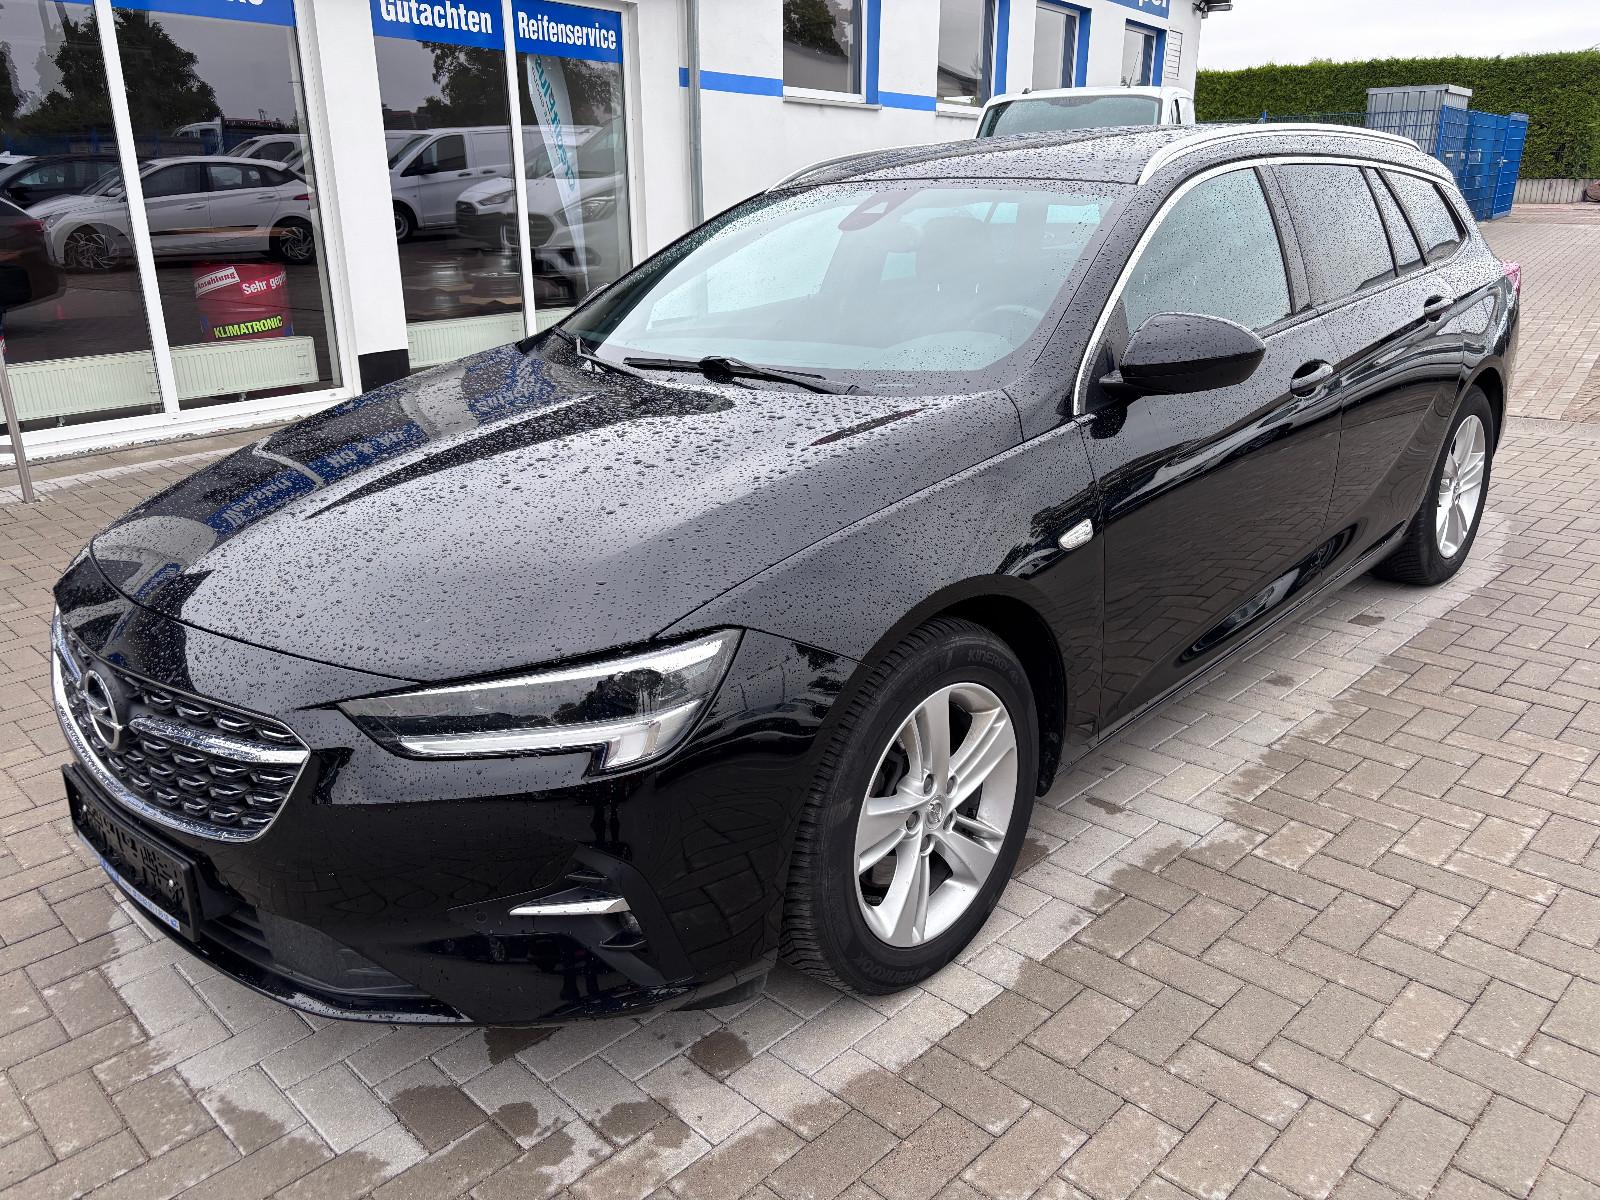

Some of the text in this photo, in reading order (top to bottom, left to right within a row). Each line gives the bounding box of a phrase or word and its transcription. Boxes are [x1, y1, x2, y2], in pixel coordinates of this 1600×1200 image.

[380, 0, 493, 34] Gutachten
[517, 12, 617, 49] Reifenservice
[241, 280, 267, 295] Sehr
[213, 315, 283, 339] KLIMATRONIC
